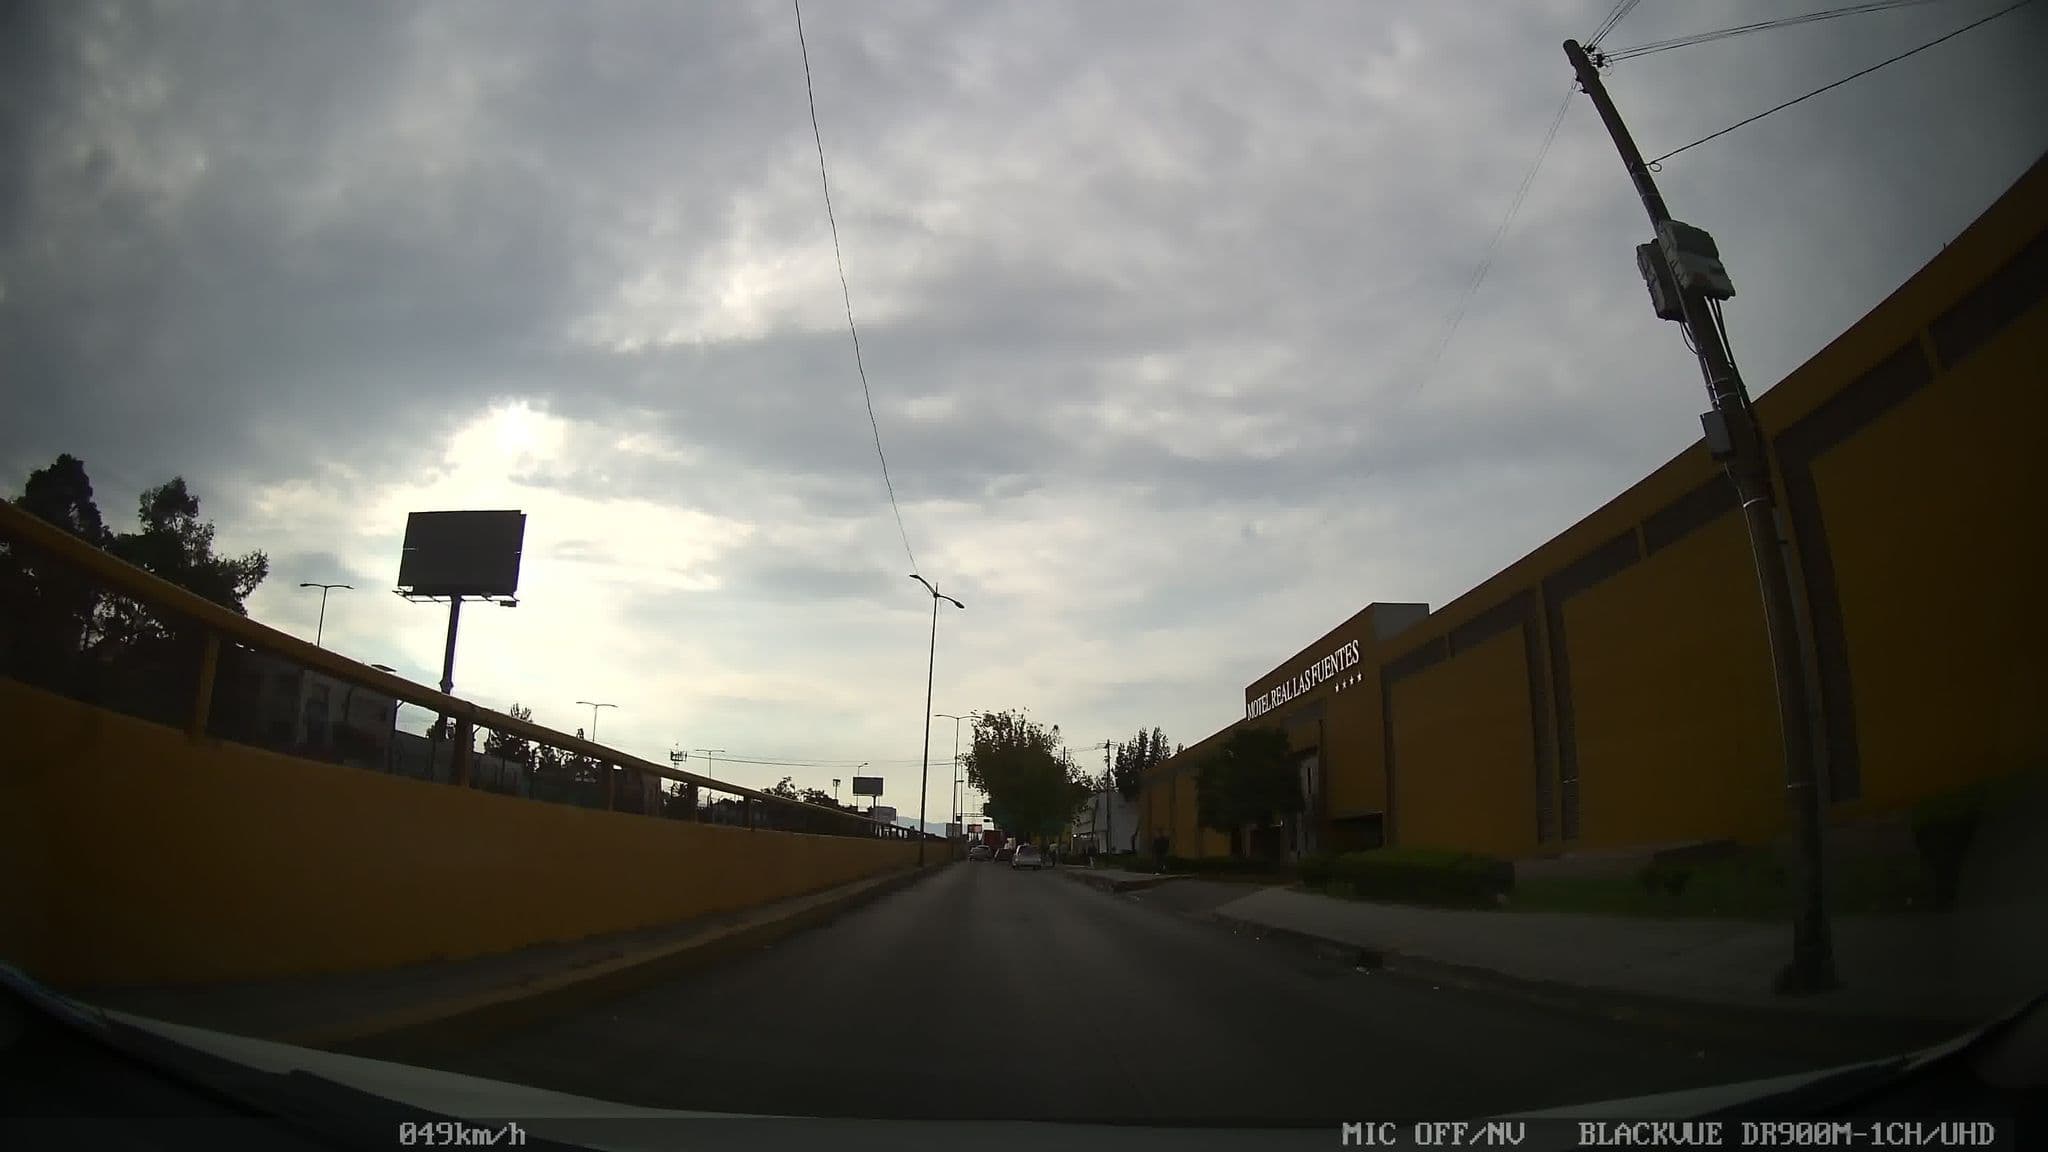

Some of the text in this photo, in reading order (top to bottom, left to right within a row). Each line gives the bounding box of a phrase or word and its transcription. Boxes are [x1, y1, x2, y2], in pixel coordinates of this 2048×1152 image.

[1247, 639, 1360, 721] MOTEL REAL LAS FUENTES
